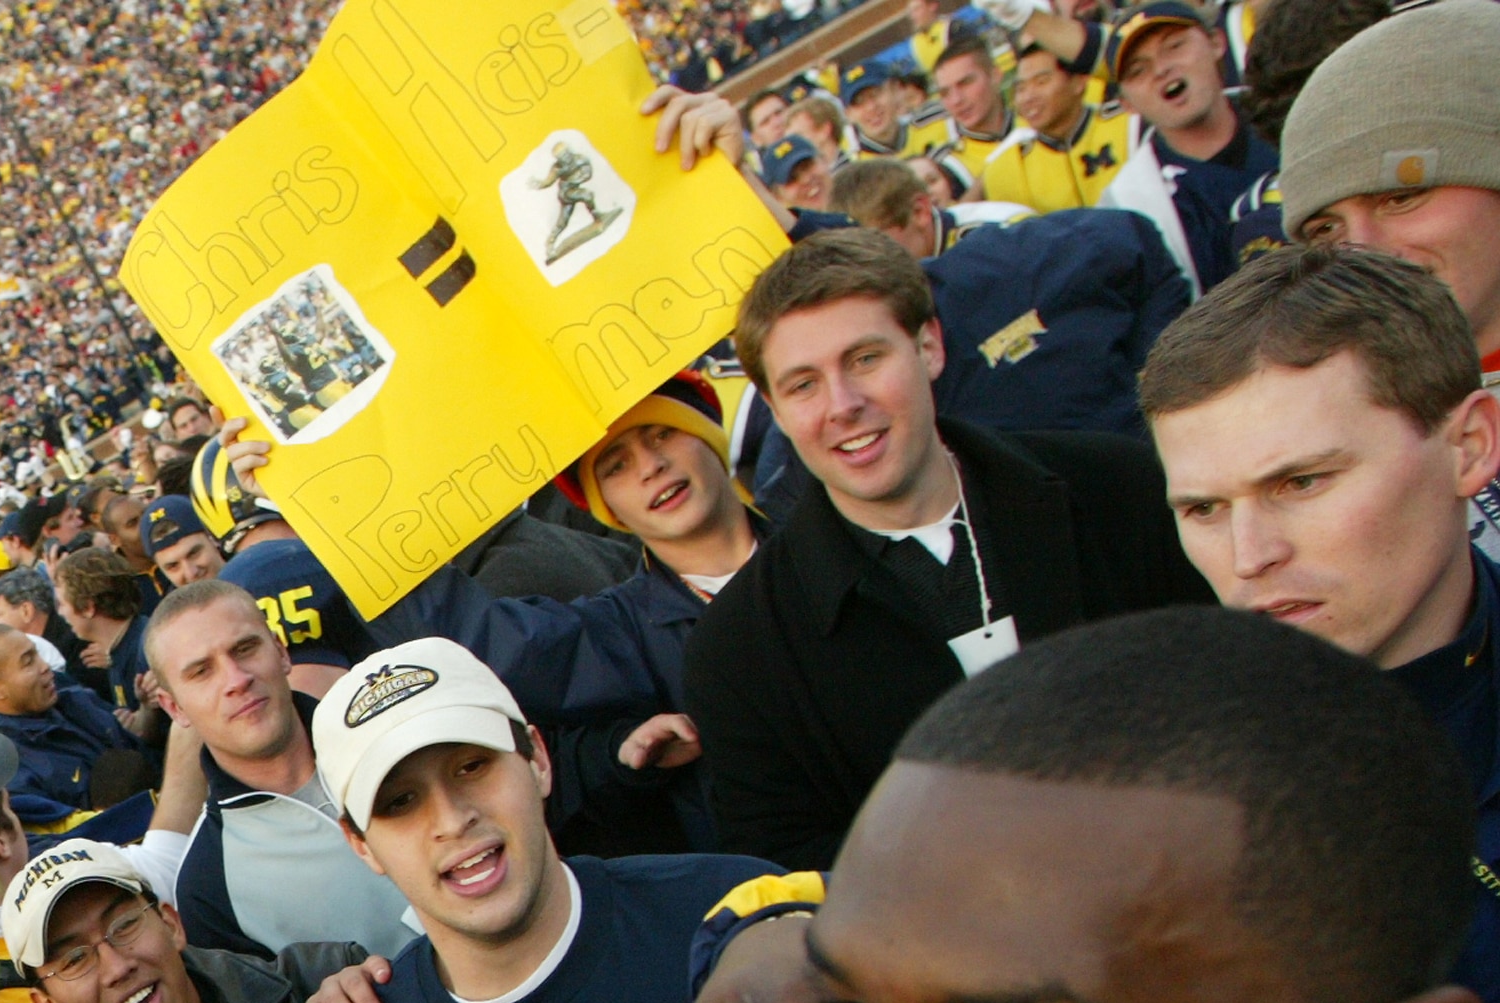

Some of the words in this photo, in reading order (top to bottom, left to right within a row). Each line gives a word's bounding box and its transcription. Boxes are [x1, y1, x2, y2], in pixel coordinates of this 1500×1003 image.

[1080, 143, 1118, 177] M
[128, 145, 359, 351] Chris
[290, 425, 557, 602] Perry
[547, 227, 779, 414] man
[348, 669, 431, 721] MICHIGAN
[14, 848, 93, 912] MICHIGAN
[42, 870, 65, 890] M
